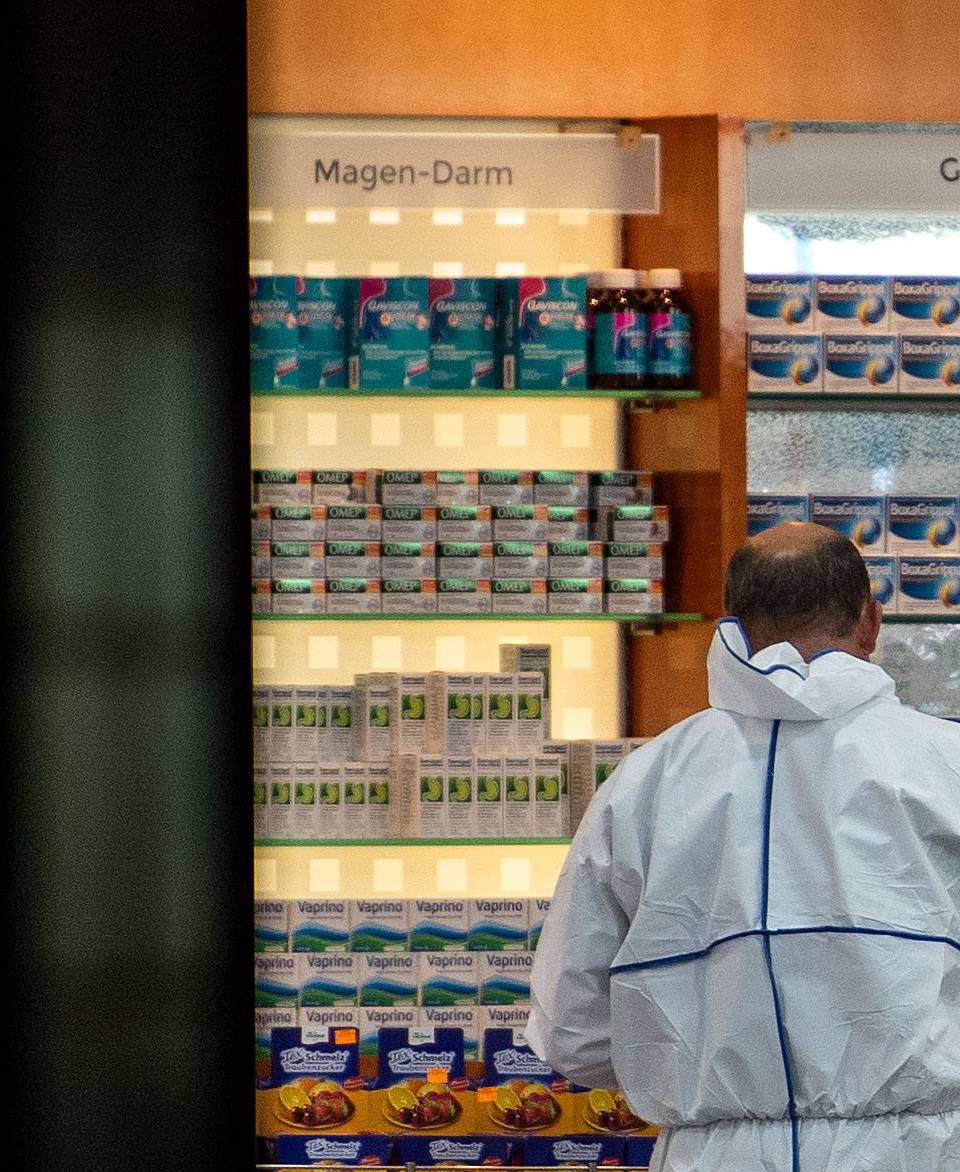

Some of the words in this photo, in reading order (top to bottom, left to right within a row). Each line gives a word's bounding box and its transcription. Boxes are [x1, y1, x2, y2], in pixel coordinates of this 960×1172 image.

[313, 158, 513, 191] Magen-Darm
[298, 900, 344, 915] Vaprino
[357, 900, 403, 915] Vaprino
[416, 900, 463, 914] Vaprino
[475, 900, 523, 914] Vaprino
[307, 955, 353, 971] Vaprino
[366, 955, 412, 970] Vaprino
[427, 955, 473, 970] Vaprino
[486, 954, 533, 969] Vaprino
[306, 1010, 353, 1025] Vaprino
[366, 1010, 413, 1025] Vaprino
[426, 1010, 473, 1025] Vaprino
[305, 1051, 345, 1063] Schmelz
[413, 1052, 452, 1063] Schmelz
